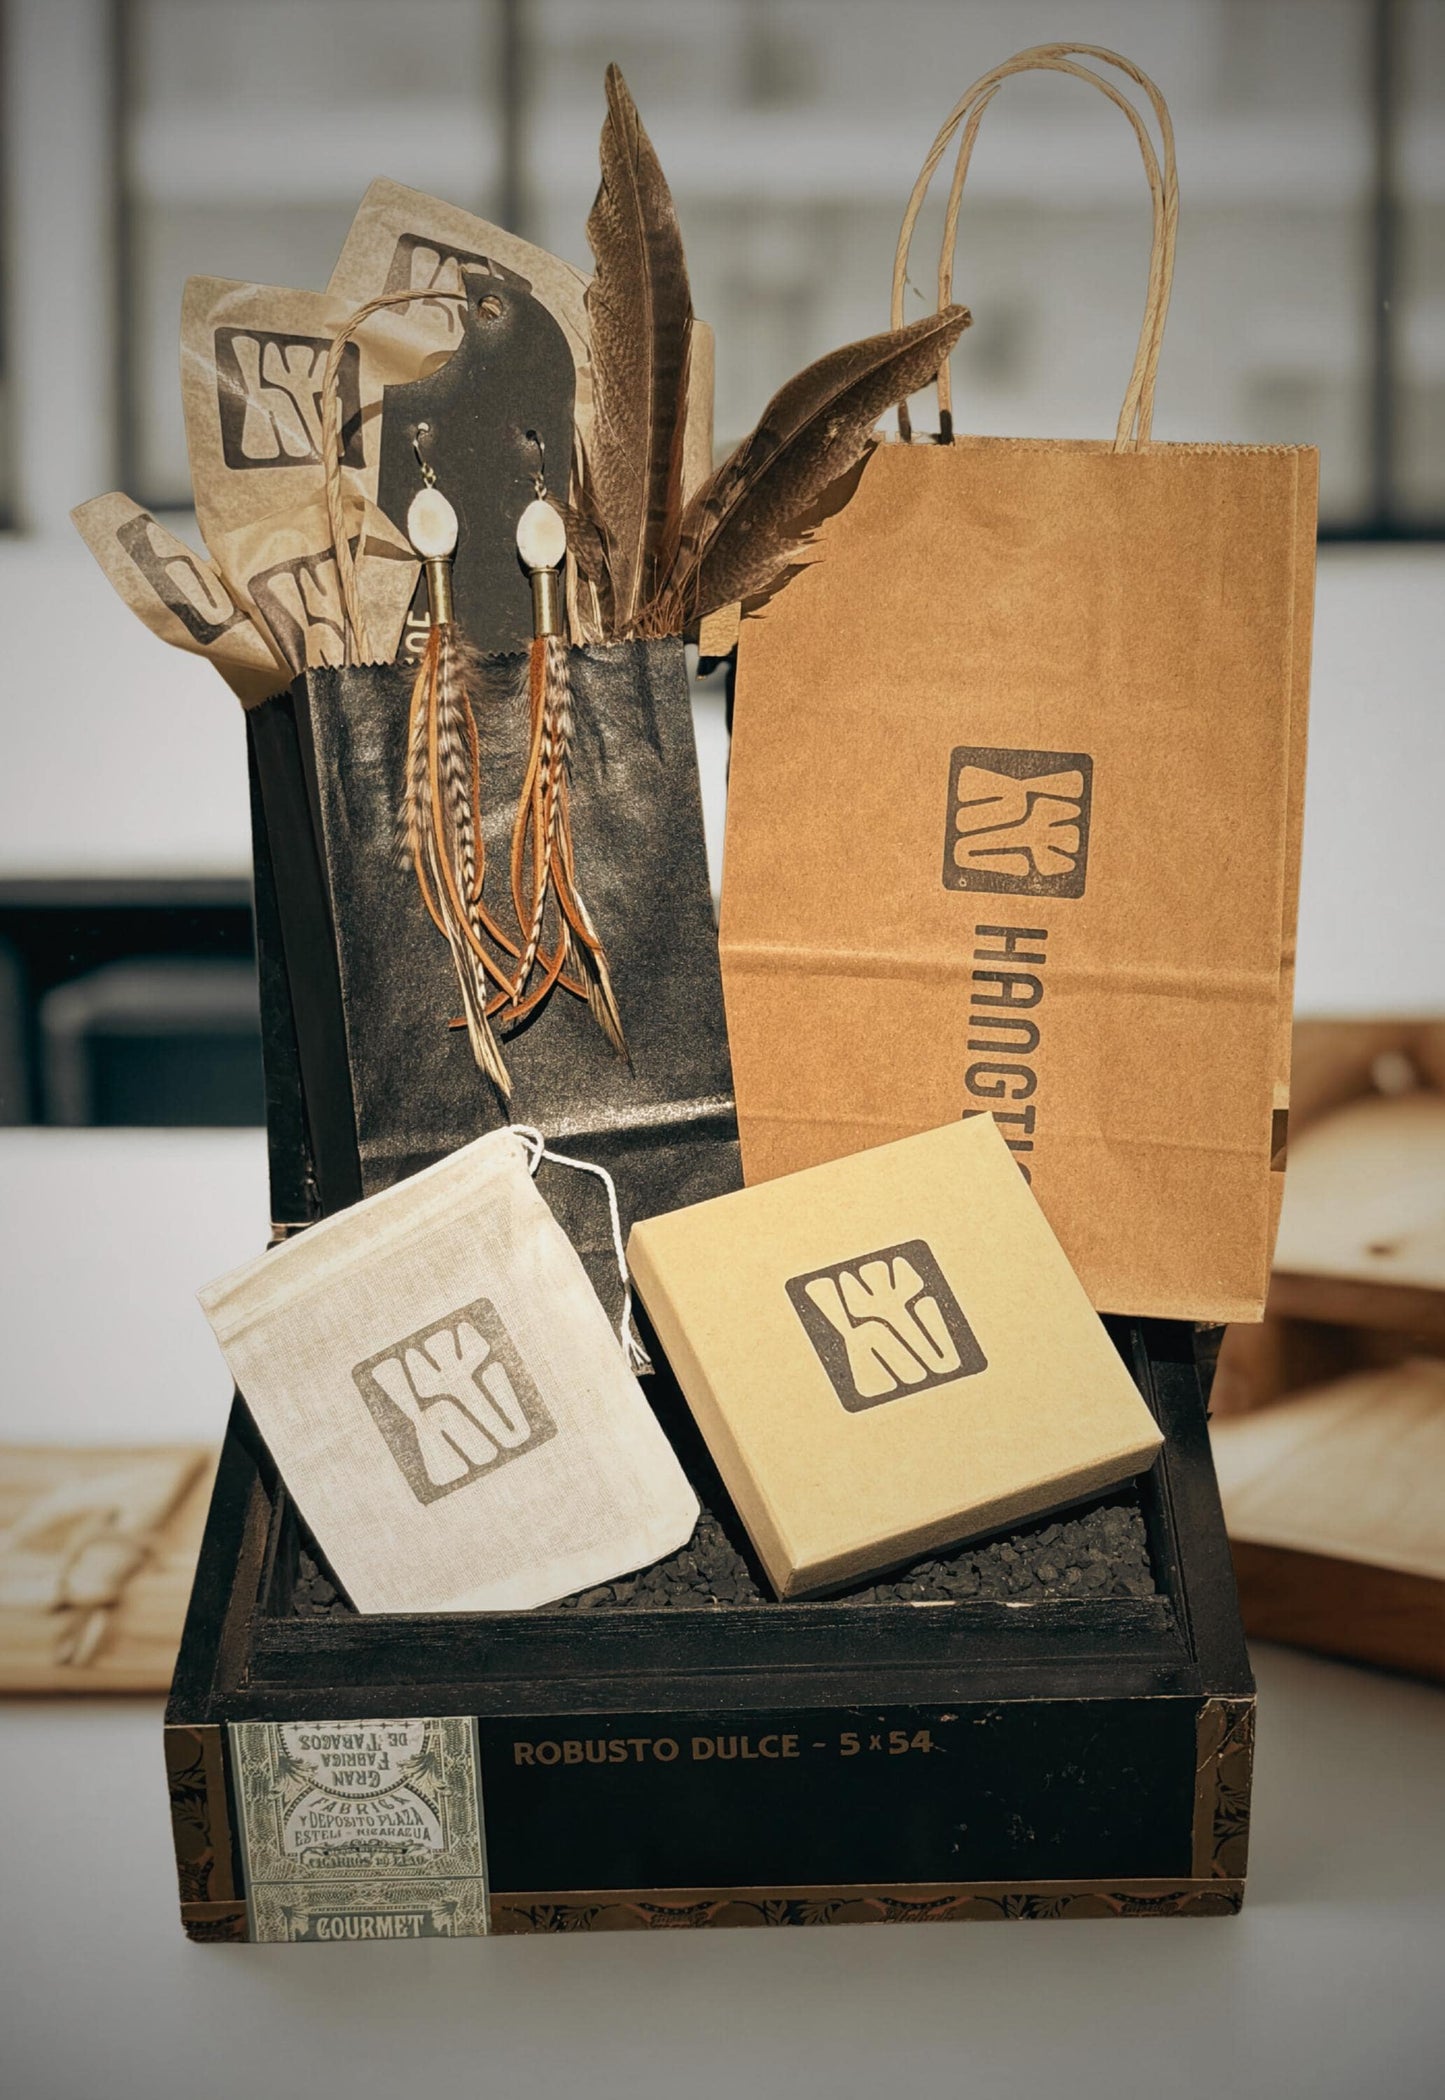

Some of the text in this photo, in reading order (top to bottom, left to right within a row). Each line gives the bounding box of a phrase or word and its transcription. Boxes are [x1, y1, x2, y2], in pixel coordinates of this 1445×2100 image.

[963, 923, 1049, 1188] HANGT
[388, 1733, 408, 1747] DE
[514, 1738, 679, 1765] ROBUSTO
[692, 1734, 800, 1761] DULCE
[840, 1732, 860, 1756] 5
[889, 1730, 933, 1754] 54
[331, 1770, 380, 1787] GRAN
[316, 1915, 426, 1939] GOURMET
